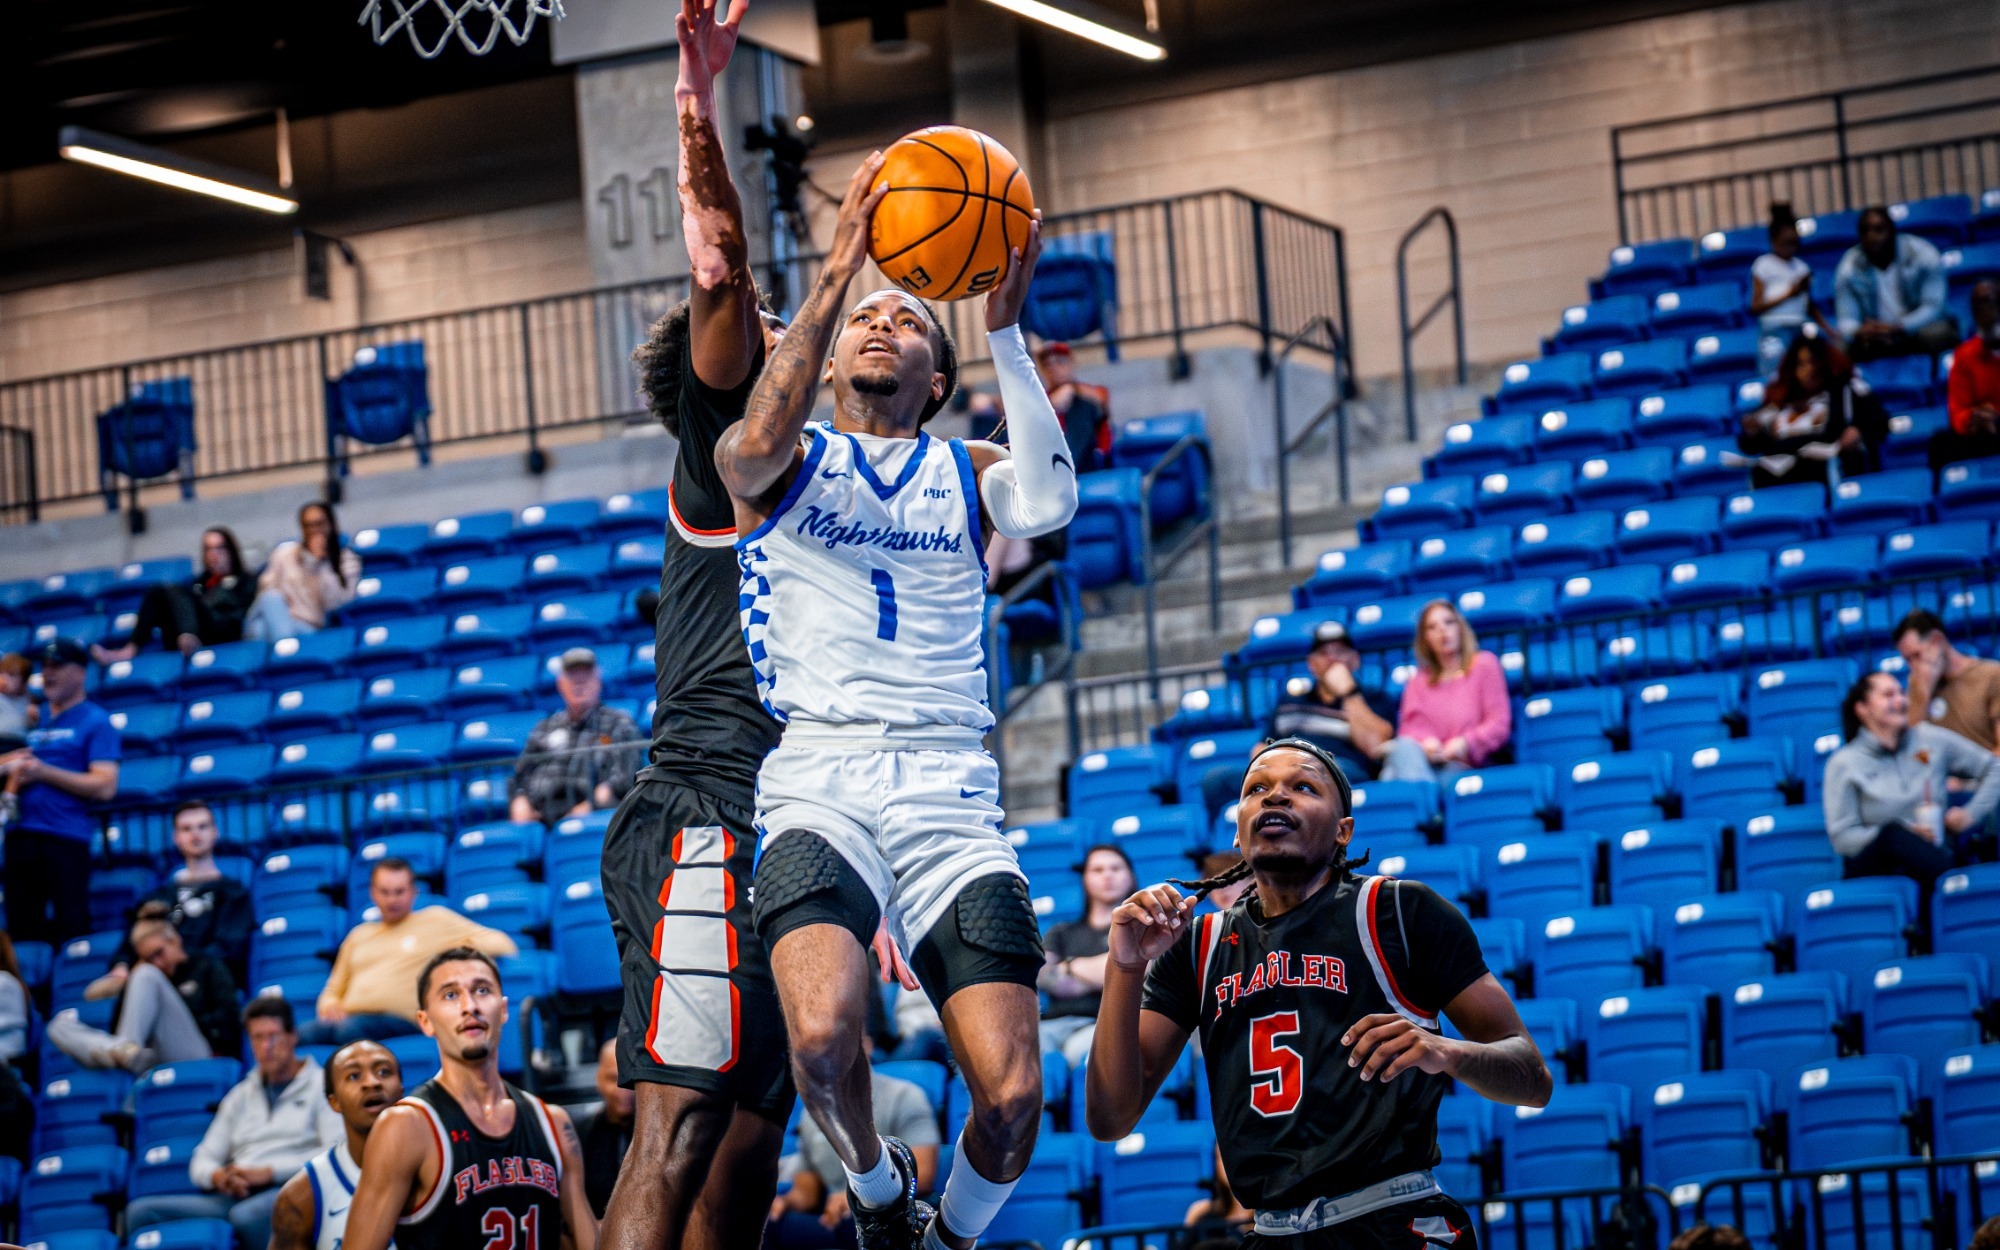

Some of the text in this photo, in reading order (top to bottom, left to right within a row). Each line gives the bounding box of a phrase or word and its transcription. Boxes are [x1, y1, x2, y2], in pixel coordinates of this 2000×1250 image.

[923, 487, 952, 499] PBC
[870, 568, 898, 642] 1
[1213, 950, 1348, 1022] FLAGLER
[1249, 1010, 1303, 1118] 5
[454, 1157, 560, 1204] FLAGLER
[482, 1205, 539, 1250] 21
